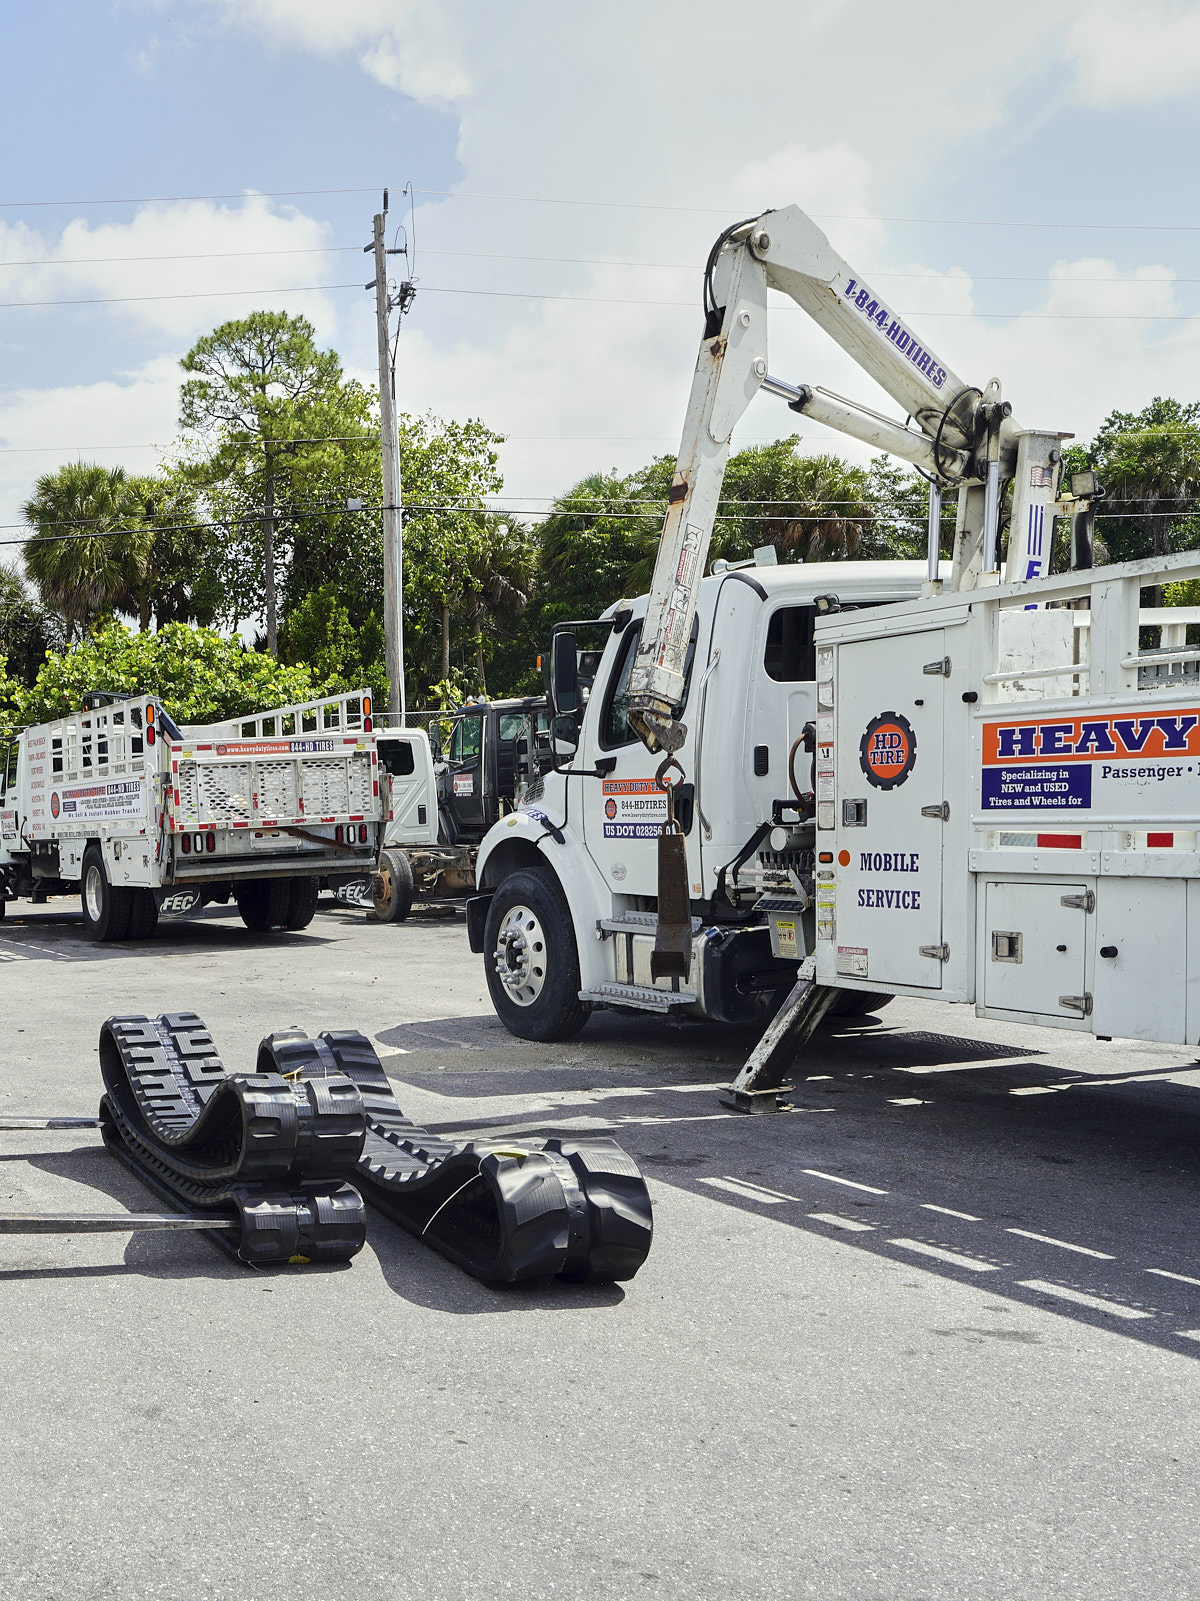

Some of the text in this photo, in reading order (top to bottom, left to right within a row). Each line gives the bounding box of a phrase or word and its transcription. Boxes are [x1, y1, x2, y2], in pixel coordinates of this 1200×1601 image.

[844, 279, 947, 389] 1-844-HDTIRES
[874, 732, 902, 750] HD
[997, 715, 1199, 758] HEAVY
[290, 742, 314, 752] 844-HD
[316, 740, 333, 751] TIRES
[870, 750, 905, 765] TIRE
[1001, 769, 1069, 781] Specializing in
[1102, 765, 1183, 781] Passenger
[604, 783, 627, 792] HEAVY
[629, 782, 649, 792] DUTY
[1001, 783, 1069, 793] NEW and USED
[622, 800, 666, 810] 844-HDTIRES
[989, 796, 1082, 806] Tires and Wheels for
[605, 825, 670, 836] US DOT 0282560
[860, 853, 919, 872] MOBILE
[338, 885, 365, 899] FEC
[163, 896, 194, 910] FEC
[858, 889, 920, 910] SERVICE
